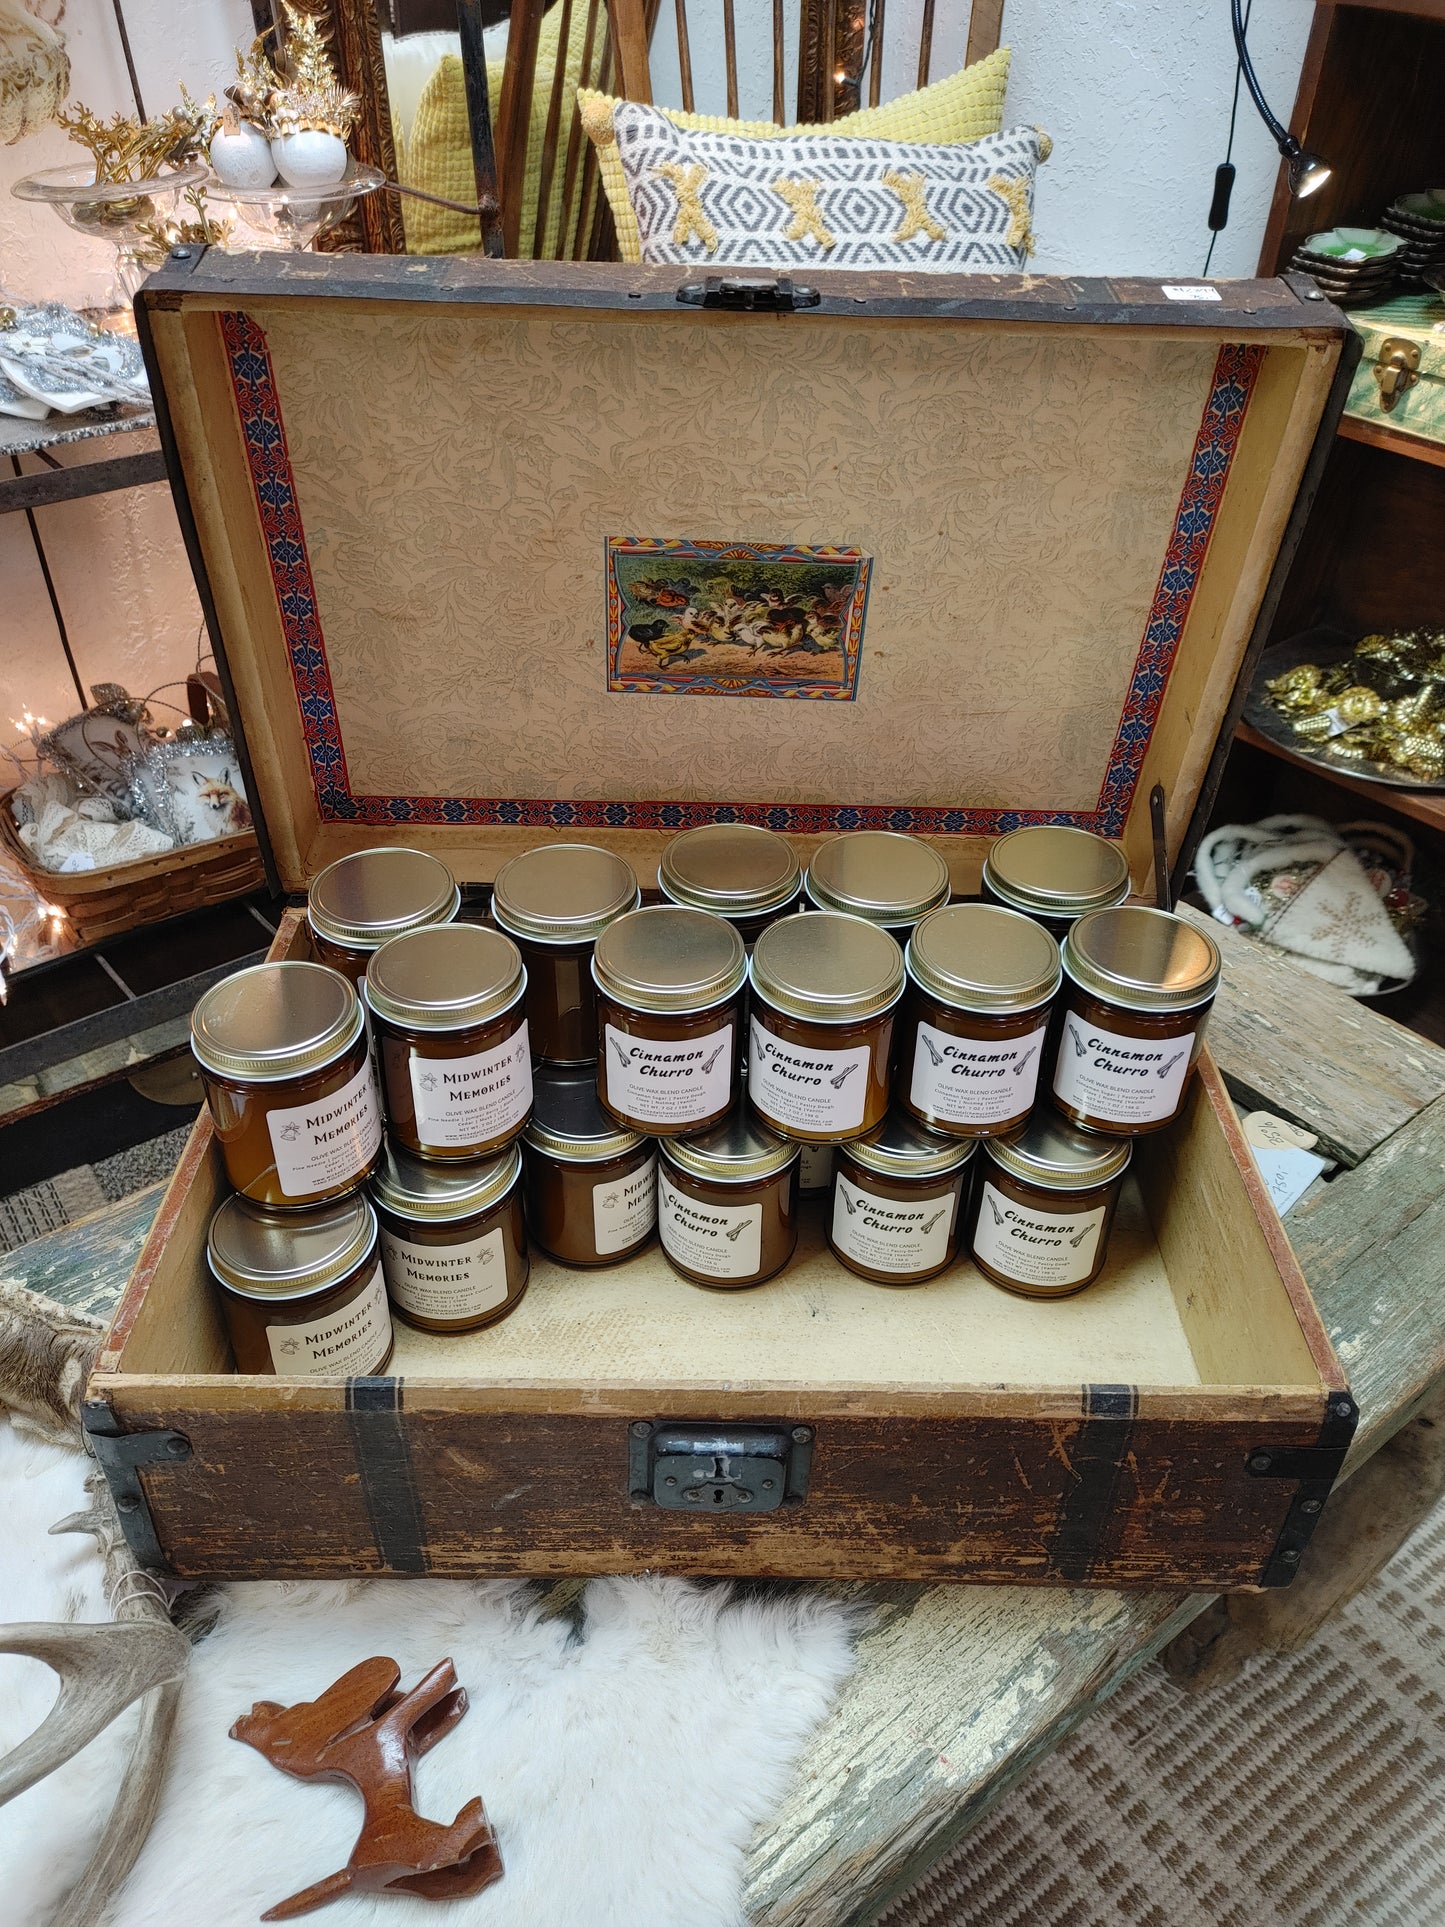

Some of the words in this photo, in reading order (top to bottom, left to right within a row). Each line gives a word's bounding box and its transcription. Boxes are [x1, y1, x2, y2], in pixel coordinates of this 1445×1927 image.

[629, 1047, 704, 1063] Cinnamon
[765, 1043, 834, 1072] Cinnamon
[943, 1046, 1018, 1062] Cinnamon
[1087, 1038, 1164, 1061] Cinnamon
[443, 1055, 513, 1084] MIDWINTER
[640, 1065, 694, 1078] Churro
[771, 1063, 822, 1086] Churro
[951, 1064, 1006, 1078] Churro
[1093, 1057, 1149, 1077] Churro
[450, 1075, 511, 1102] MEMORIES
[629, 1083, 644, 1092] OLIVE
[681, 1085, 703, 1094] CANDLE
[937, 1082, 953, 1091] OLIVE
[990, 1086, 1012, 1094] CANDLE
[1079, 1074, 1094, 1084] OLIVE
[1095, 1081, 1109, 1089] WAX
[306, 1084, 367, 1129] MIDWINTER
[479, 1101, 497, 1111] BLEND
[788, 1092, 807, 1101] BLEND
[314, 1104, 368, 1145] MEMORIES
[1258, 1121, 1284, 1146] 35%
[668, 1194, 729, 1226] Cinnamon
[855, 1199, 925, 1221] Cinnamon
[674, 1213, 718, 1237] Churro
[862, 1216, 913, 1234] Churro
[1004, 1210, 1075, 1234] Cinnamon
[1010, 1228, 1062, 1247] Churro
[401, 1250, 472, 1267] MIDWINTER
[406, 1267, 470, 1282] MEMORIES
[454, 1285, 476, 1294] CANDLE
[305, 1301, 372, 1346] MIDWINTER
[313, 1319, 373, 1360] MEMORIES
